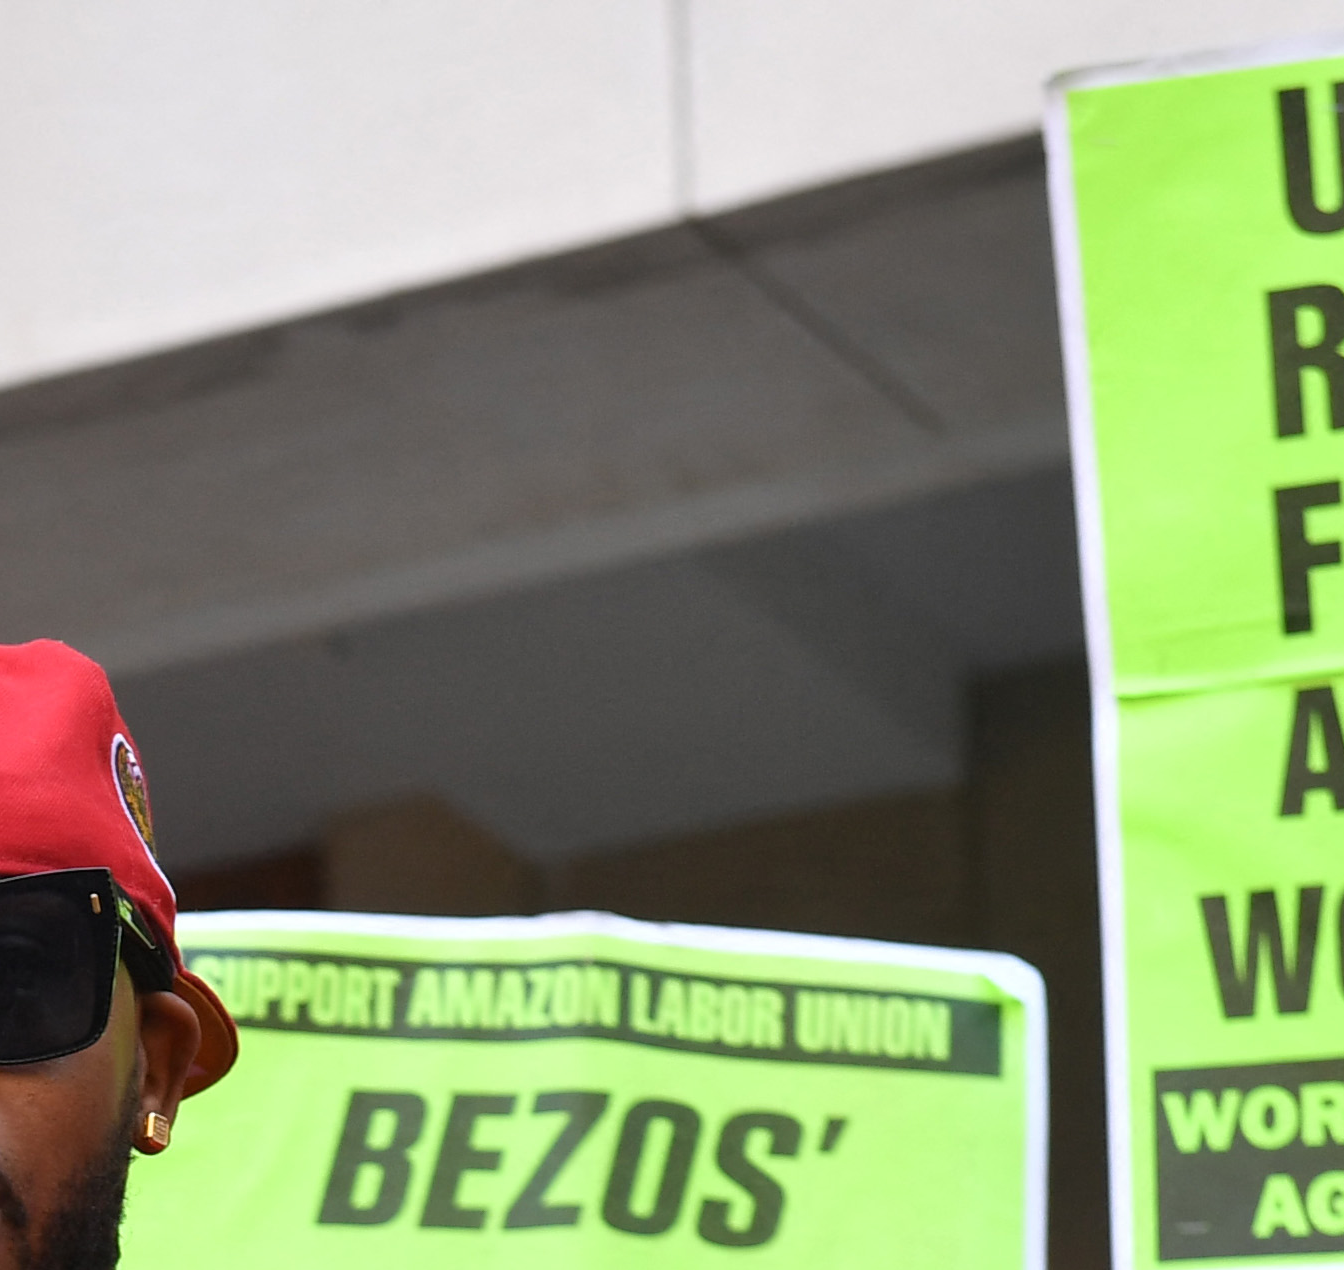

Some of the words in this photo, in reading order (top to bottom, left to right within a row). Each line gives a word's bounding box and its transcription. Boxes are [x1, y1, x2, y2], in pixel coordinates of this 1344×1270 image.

[405, 964, 623, 1032] AMAZON
[630, 970, 785, 1052] LABOR
[796, 989, 953, 1062] UNION
[317, 1088, 846, 1248] BEZOS'
